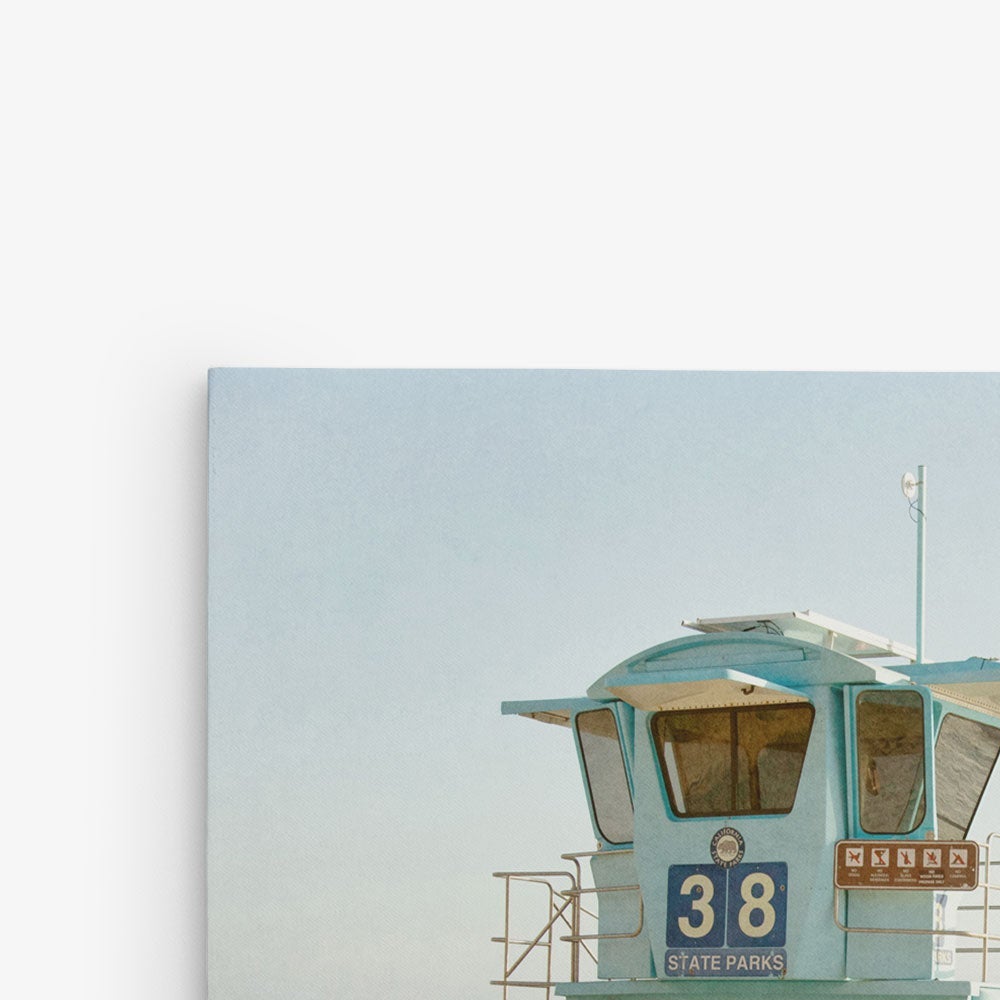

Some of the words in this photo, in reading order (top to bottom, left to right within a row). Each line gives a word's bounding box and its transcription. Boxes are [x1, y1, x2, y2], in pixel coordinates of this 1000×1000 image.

[712, 828, 743, 846] CALIFORNIA
[711, 850, 727, 868] STATE
[729, 850, 744, 867] PARKS
[668, 955, 720, 970] STATE
[726, 954, 784, 970] PARKS
